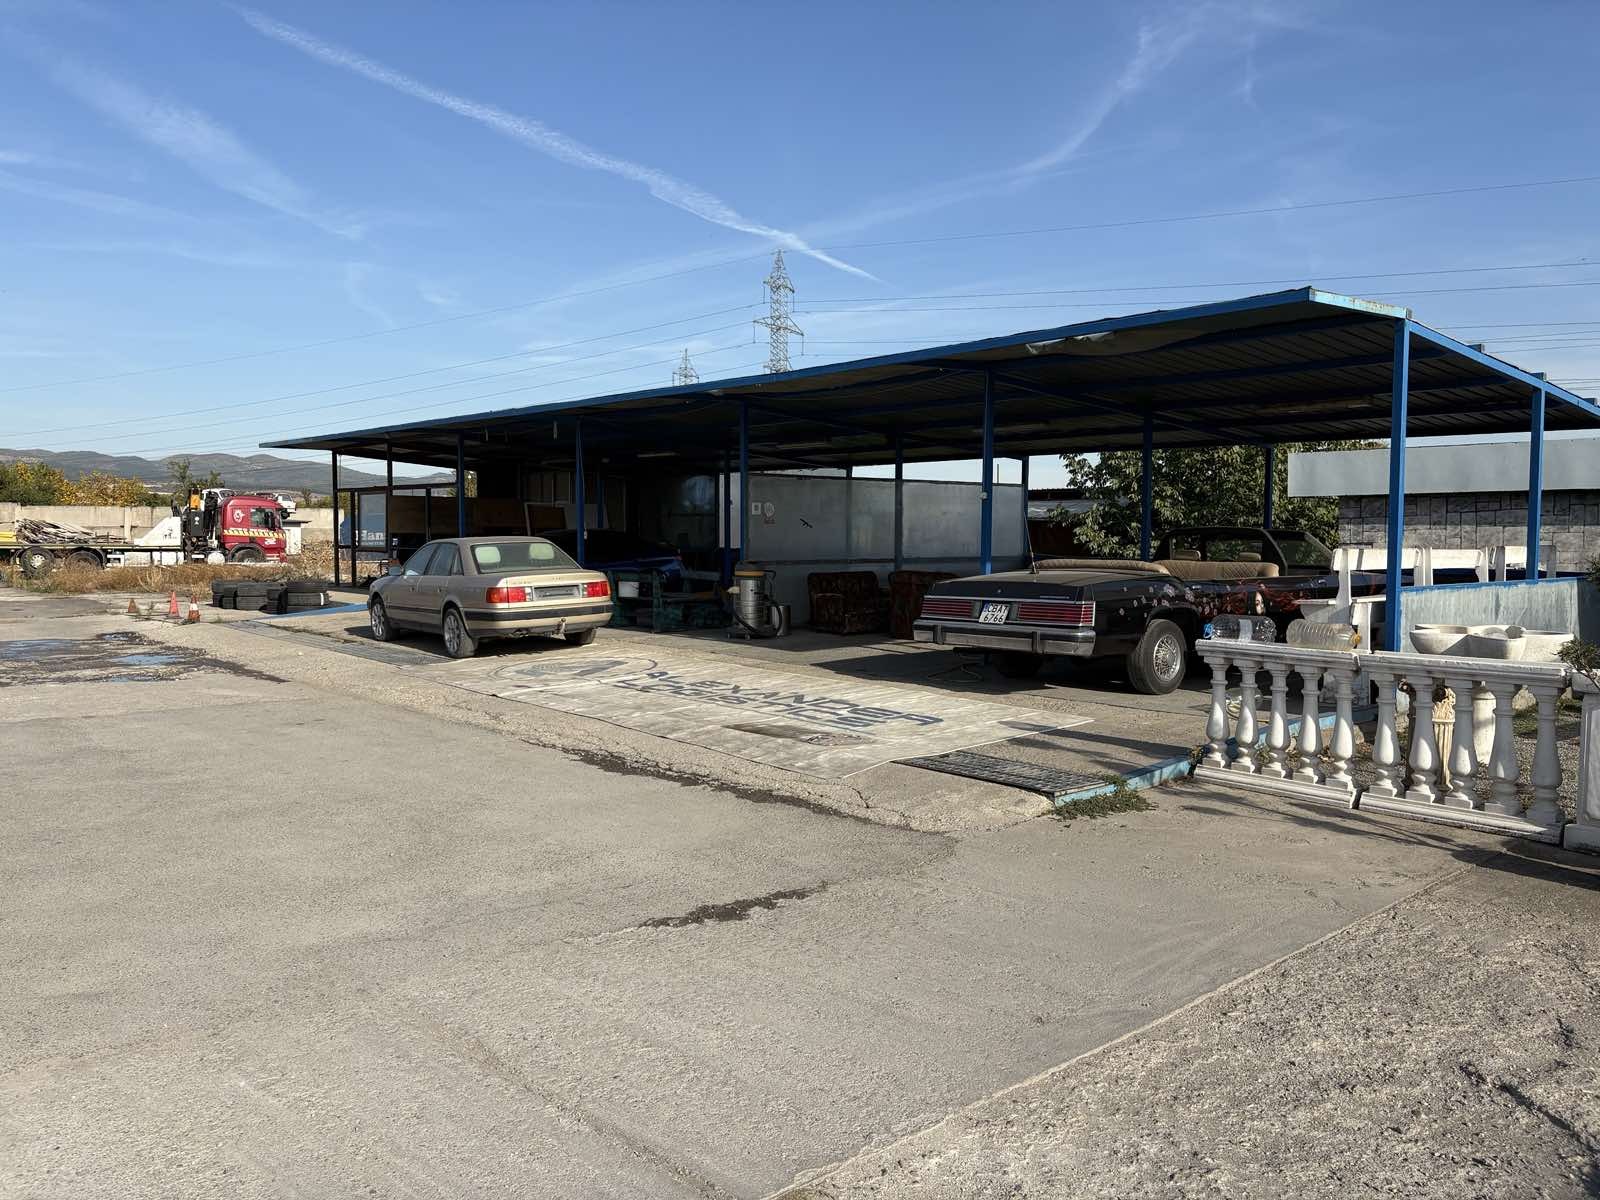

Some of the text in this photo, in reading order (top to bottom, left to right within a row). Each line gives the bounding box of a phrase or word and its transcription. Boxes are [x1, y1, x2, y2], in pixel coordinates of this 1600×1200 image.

[983, 613, 1004, 623] 6766
[613, 679, 886, 729] LOGISTICS
[645, 671, 945, 727] ALEXANDER
